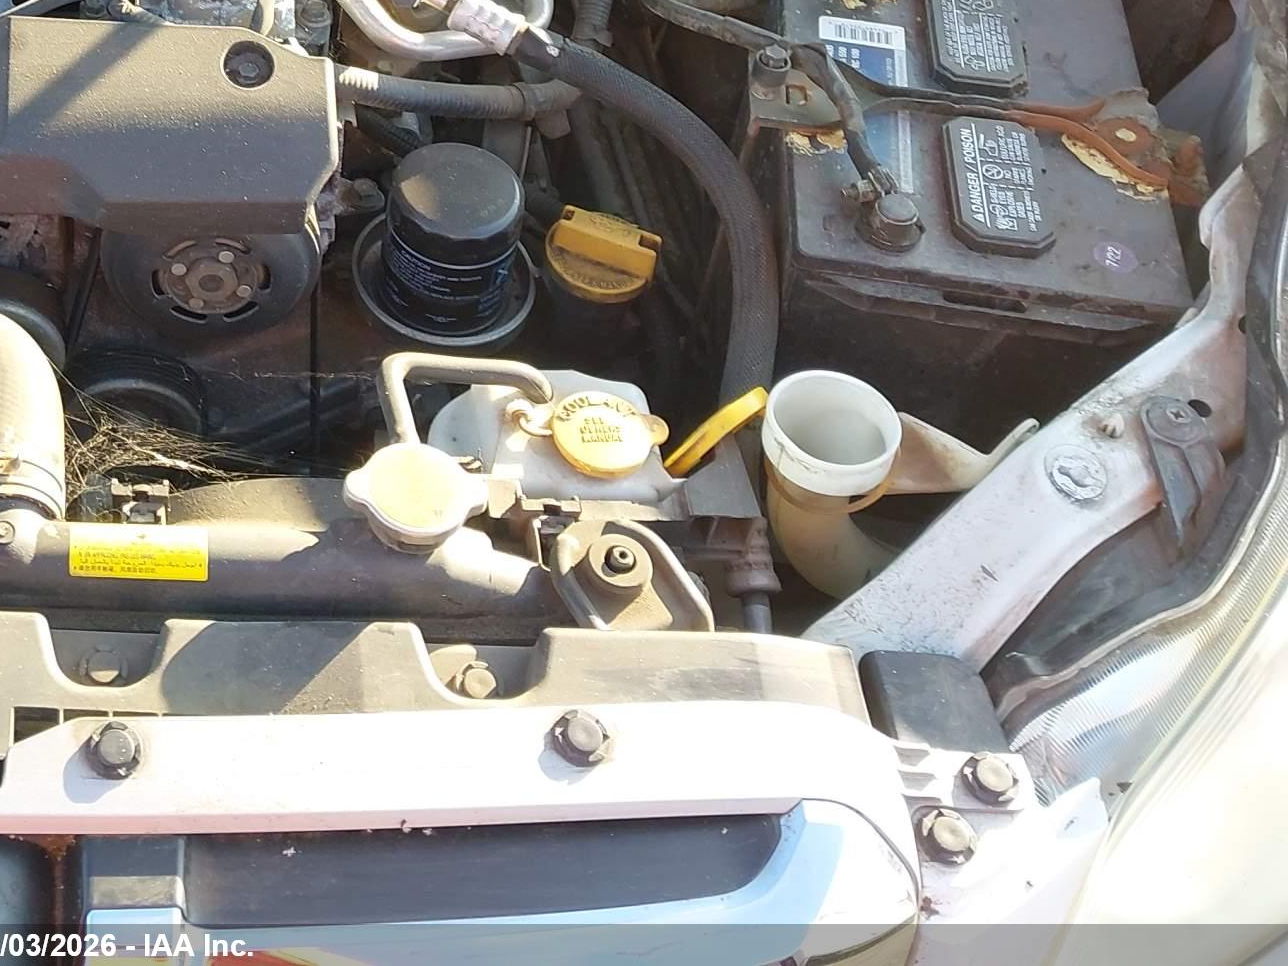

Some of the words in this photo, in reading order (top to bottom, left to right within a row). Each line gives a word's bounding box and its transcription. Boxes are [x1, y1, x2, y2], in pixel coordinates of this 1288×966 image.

[959, 128, 976, 163] POISON
[964, 163, 977, 172] /
[1003, 169, 1012, 179] NO
[966, 172, 984, 212] DANGER
